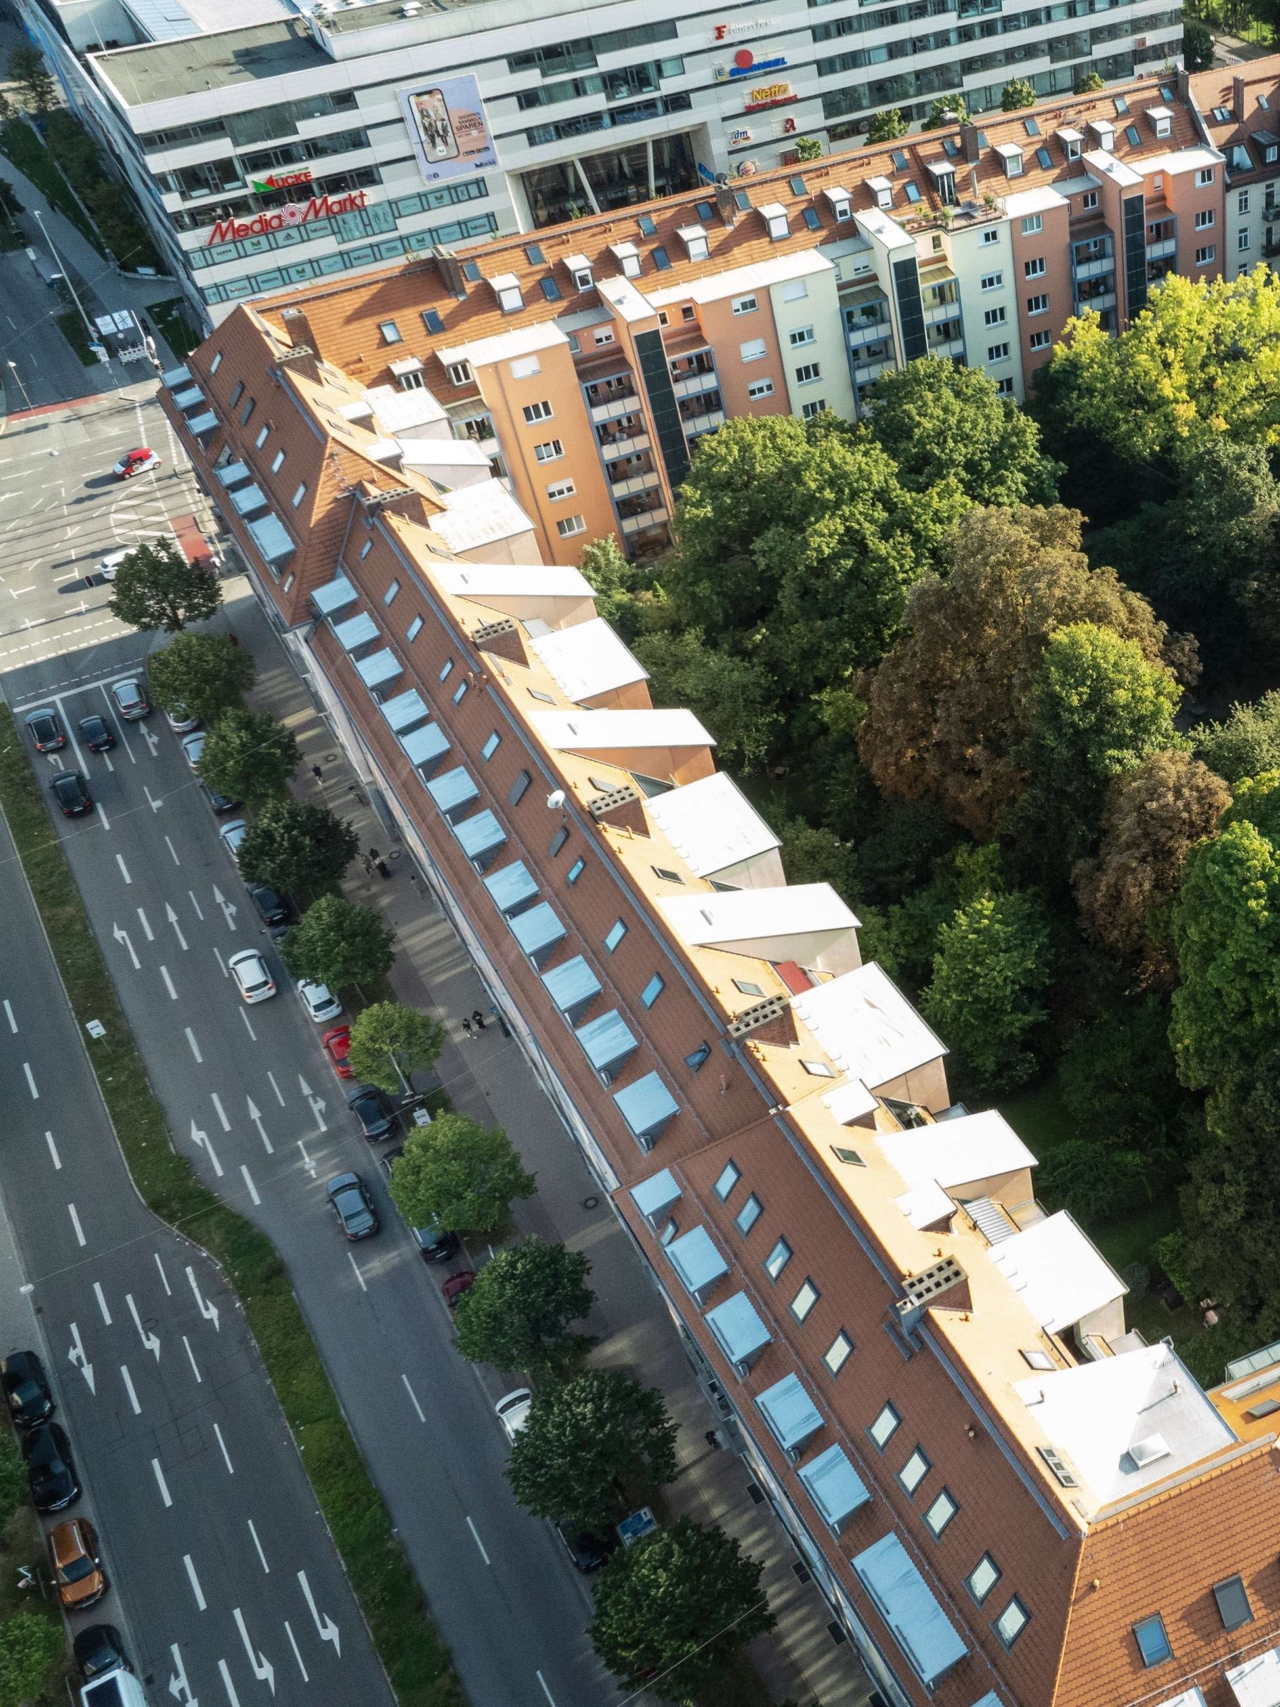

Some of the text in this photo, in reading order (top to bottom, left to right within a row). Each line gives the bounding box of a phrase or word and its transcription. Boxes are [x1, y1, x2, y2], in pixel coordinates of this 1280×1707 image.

[752, 84, 788, 102] Netto
[456, 121, 484, 131] SPAREN
[208, 190, 367, 246] Media Markt
